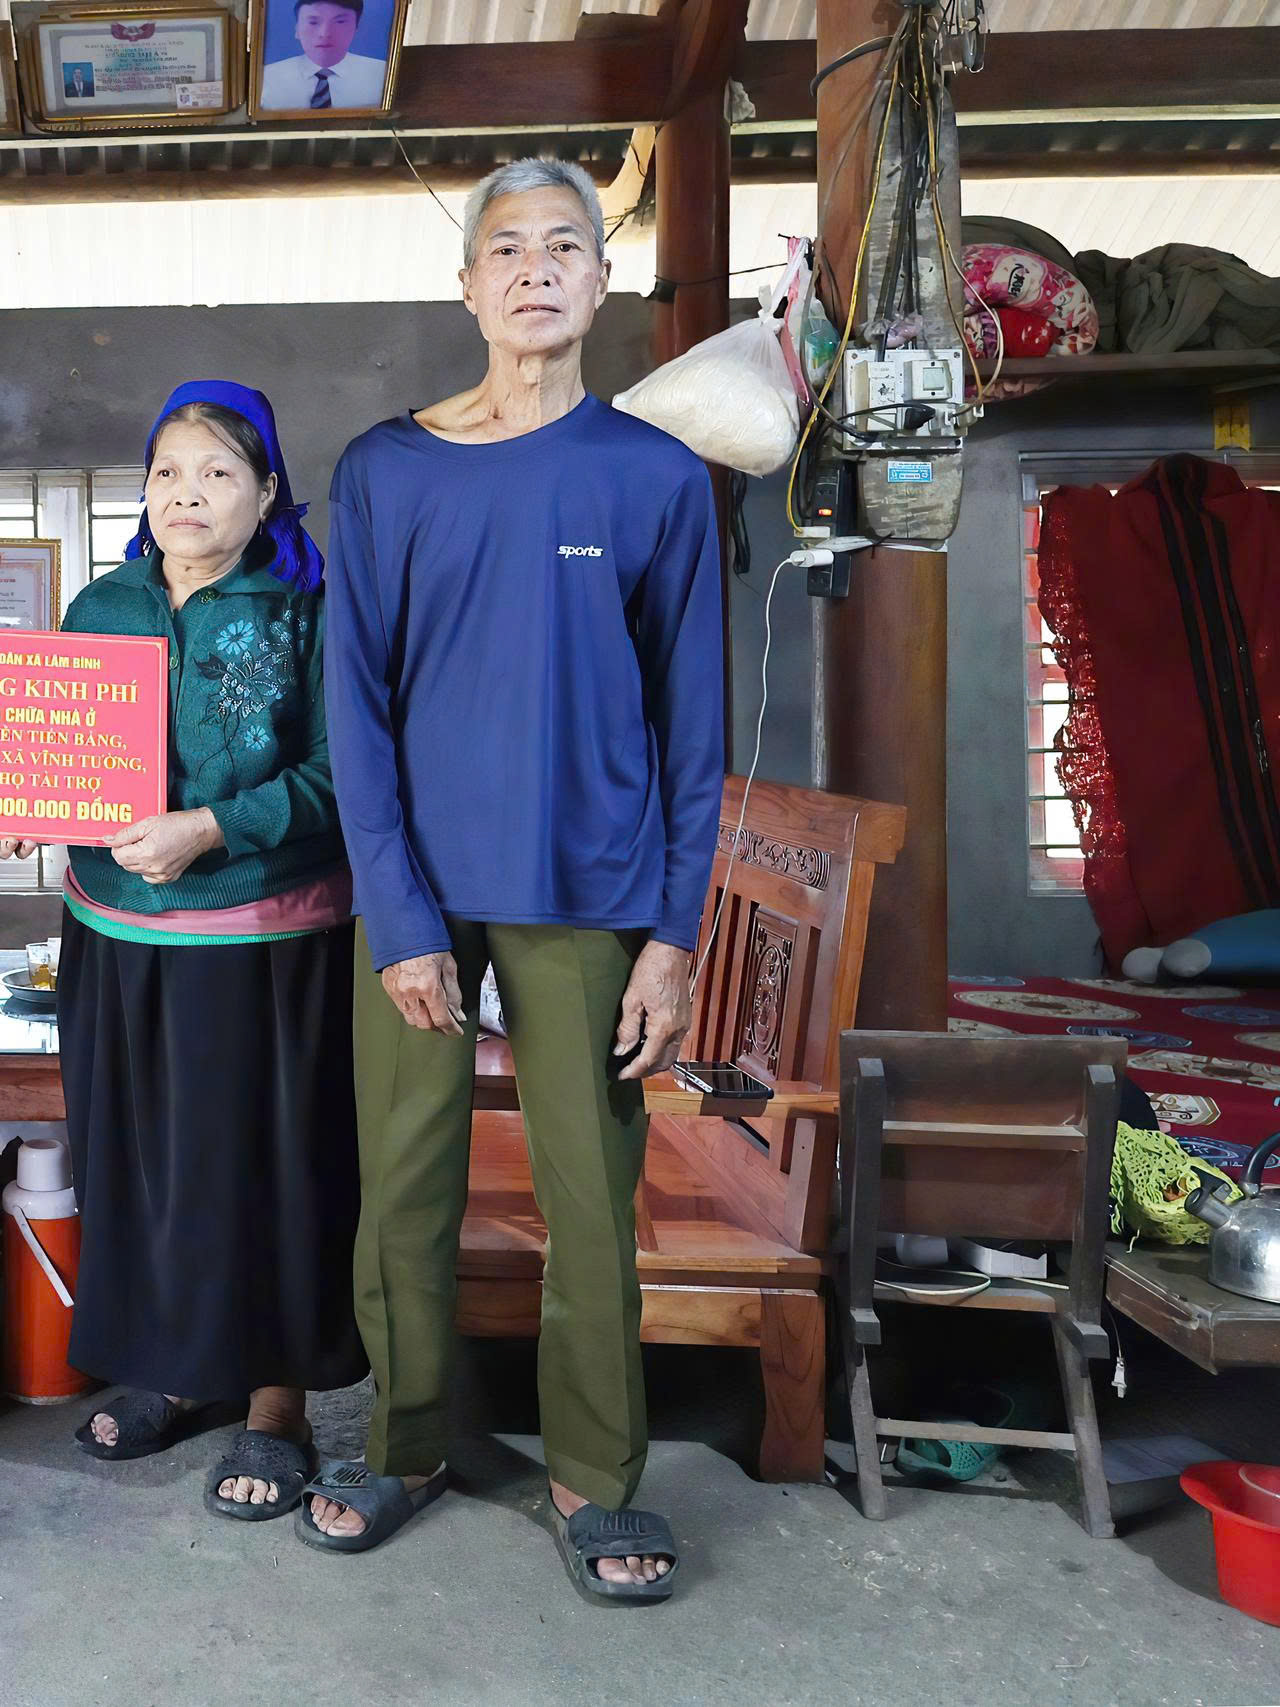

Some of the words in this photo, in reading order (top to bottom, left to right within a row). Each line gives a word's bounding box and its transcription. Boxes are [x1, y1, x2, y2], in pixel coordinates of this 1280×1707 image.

[557, 545, 604, 559] sports
[26, 653, 41, 667] XÃ
[44, 654, 70, 669] LÂM
[73, 655, 101, 670] BÌNH
[24, 678, 88, 701] KINH
[96, 679, 139, 704] PHÍ
[5, 705, 46, 725] CHỮA
[50, 708, 81, 727] NHÀ
[85, 706, 97, 728] Ở
[1, 748, 25, 765] XÃ
[30, 749, 74, 768] VĨNH
[28, 770, 60, 789] TÀI
[64, 775, 102, 794] TRỢ
